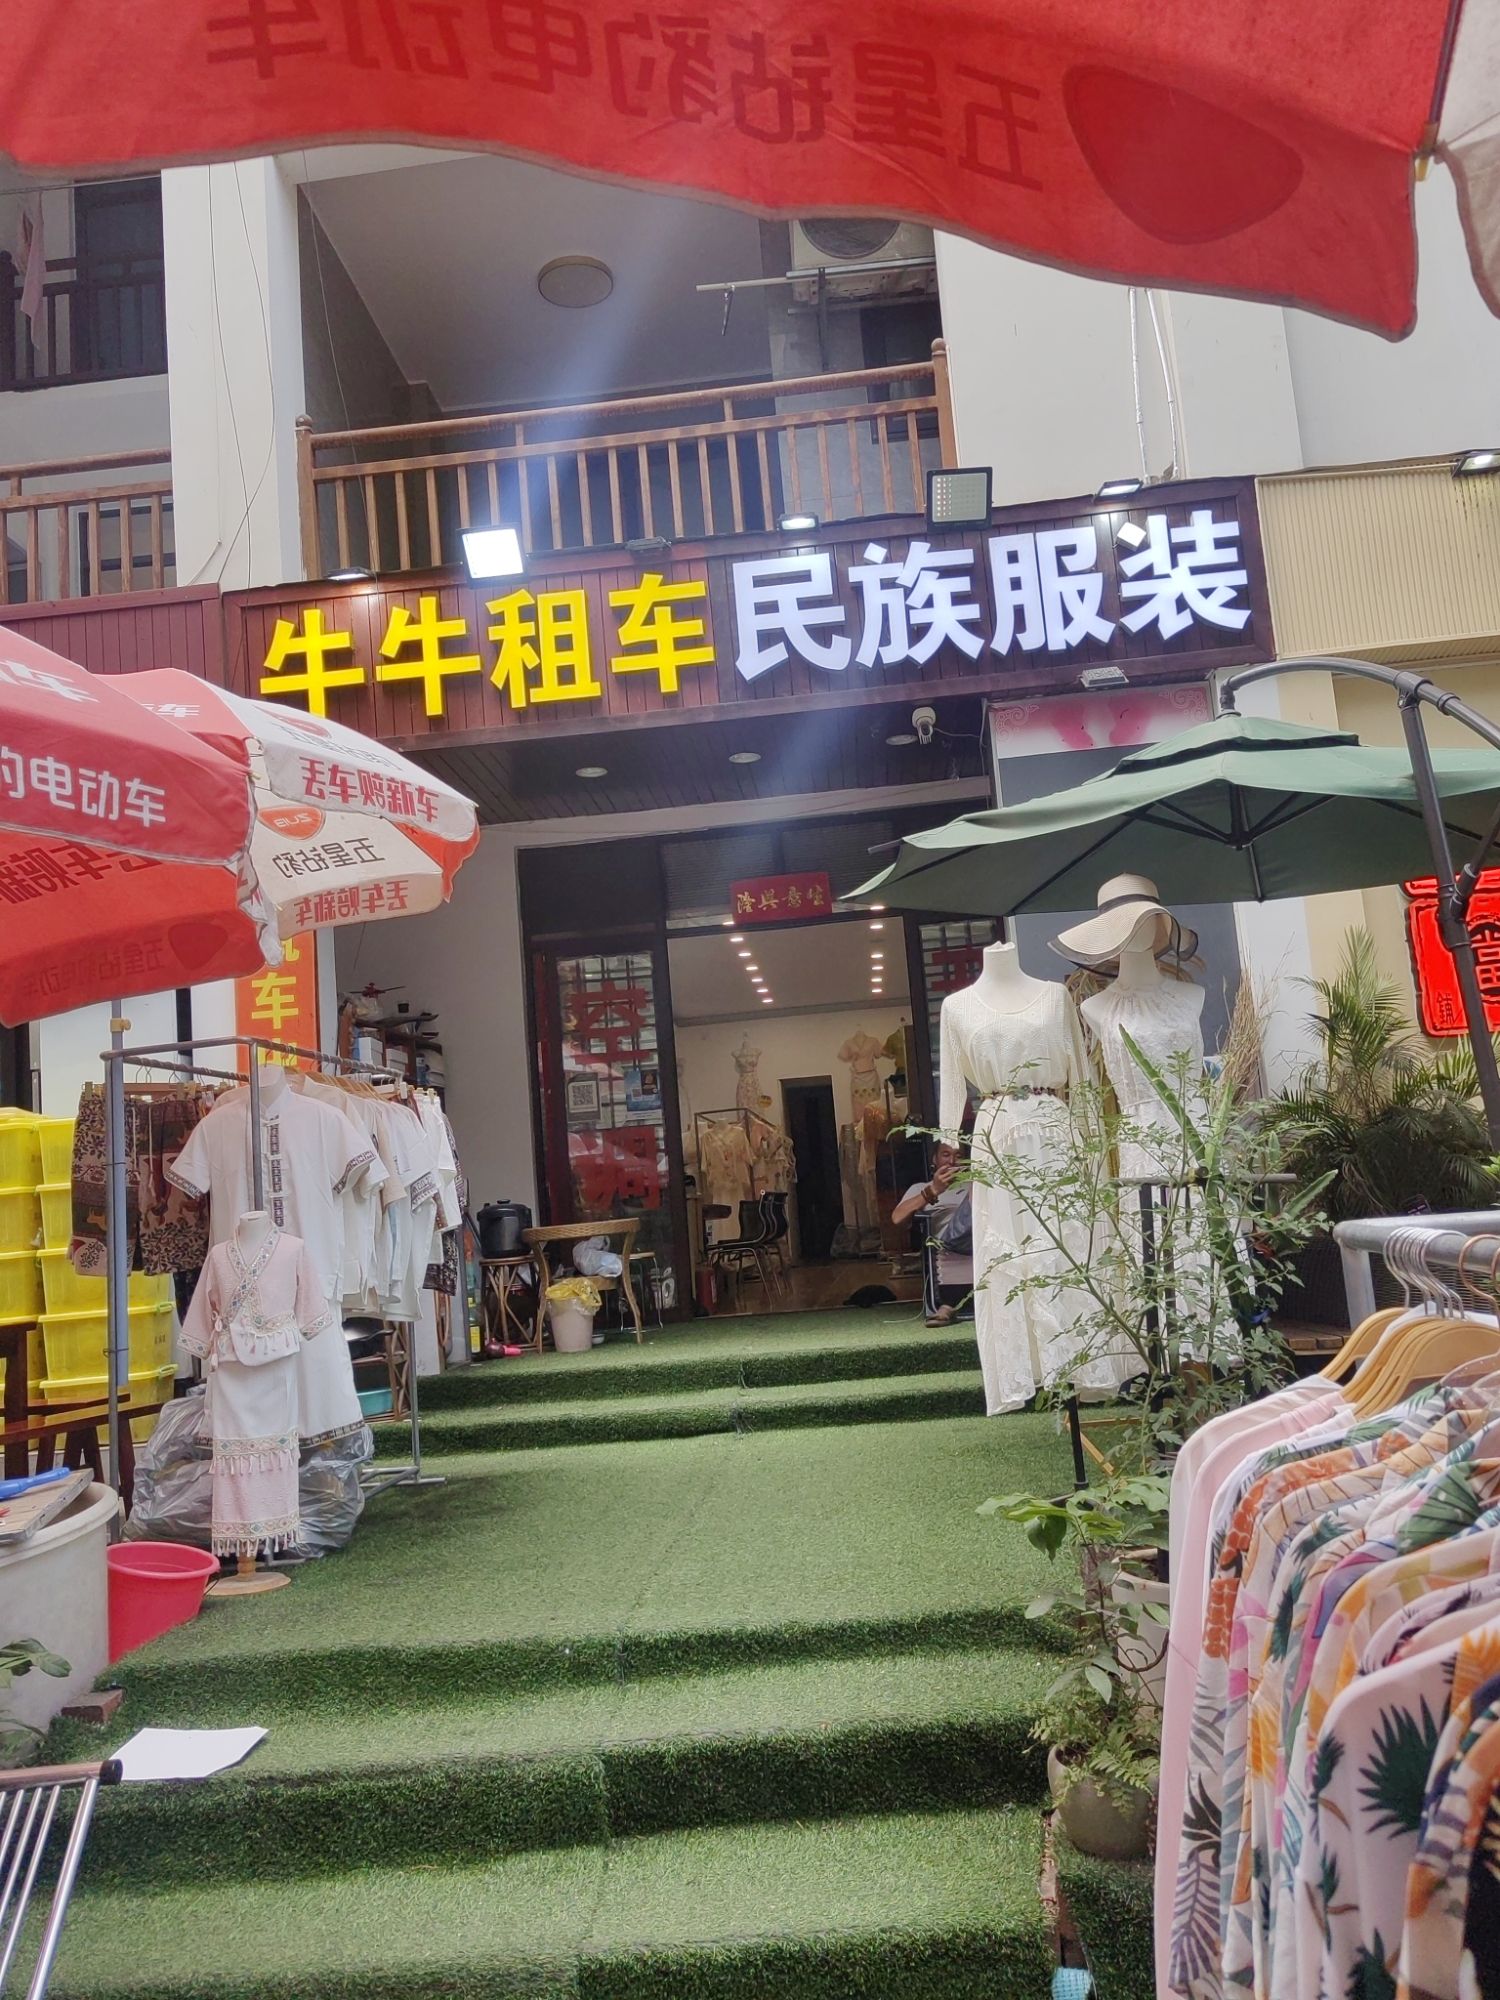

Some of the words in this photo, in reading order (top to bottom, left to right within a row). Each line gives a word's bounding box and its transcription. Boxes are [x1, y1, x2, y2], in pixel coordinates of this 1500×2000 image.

[259, 572, 716, 719] 牛牛租车
[732, 509, 1253, 681] 民族服装
[299, 756, 440, 824] 丢车赔新车
